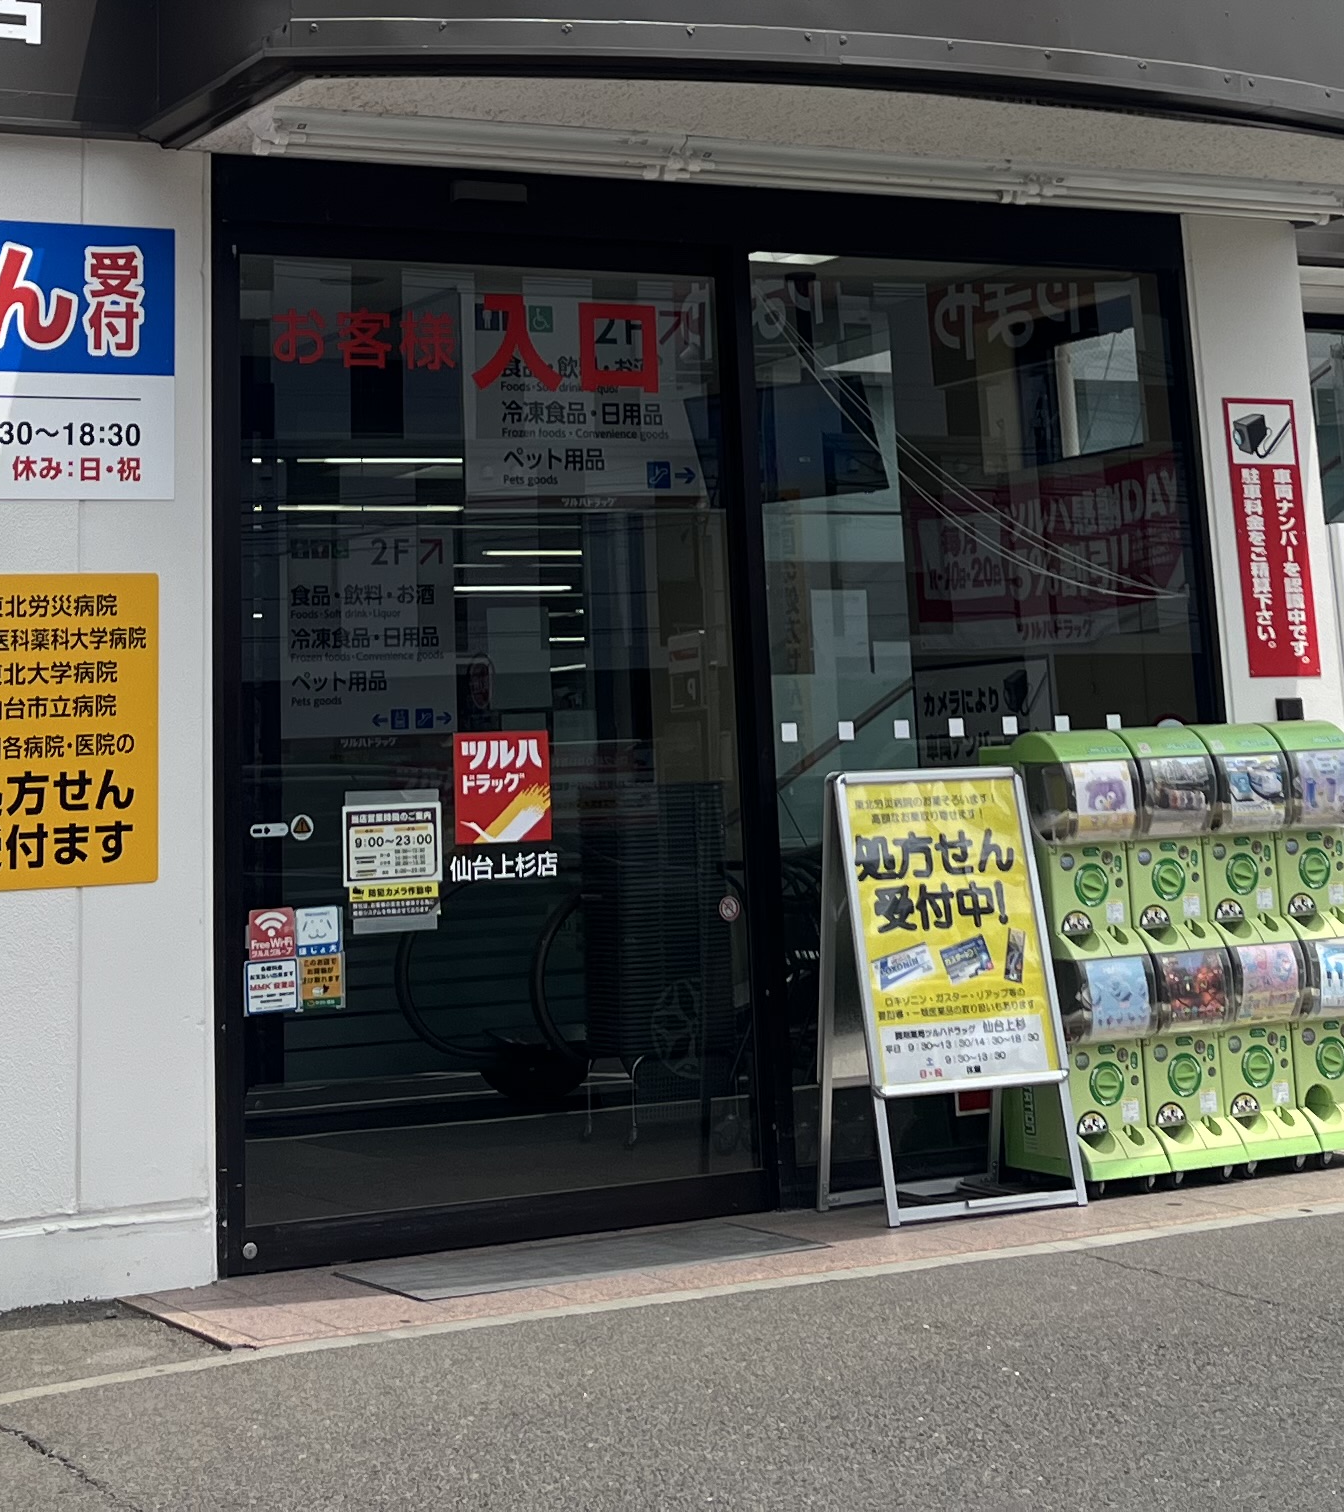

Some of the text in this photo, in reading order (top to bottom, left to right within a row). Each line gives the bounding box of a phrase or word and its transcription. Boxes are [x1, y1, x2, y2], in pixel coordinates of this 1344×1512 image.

[83, 244, 145, 357] 受付
[271, 307, 456, 371] お客様
[471, 293, 660, 394] 入口
[501, 399, 663, 427] 冷凍食品・日用品
[501, 427, 669, 443] Frozen goods
[502, 447, 605, 472] ペット用品
[502, 474, 558, 487] Pets goods
[561, 496, 618, 508] ツルハドラッグ
[370, 538, 409, 566] 2F
[290, 584, 436, 607] 食品・飲料・お酒
[290, 626, 440, 650] 冷凍食品・日用品
[290, 669, 388, 693] ペット用品
[291, 696, 342, 709] Pets goods
[923, 686, 999, 717] カメラにより
[340, 737, 397, 749] ツルハドラッグ
[461, 739, 543, 770] ツルハ
[462, 772, 526, 795] ドラッグ
[449, 851, 558, 882] 仙台上杉店
[855, 828, 1014, 882] 処方せん
[874, 880, 1009, 934] 受付中!
[982, 1017, 1027, 1034] 仙台上杉
